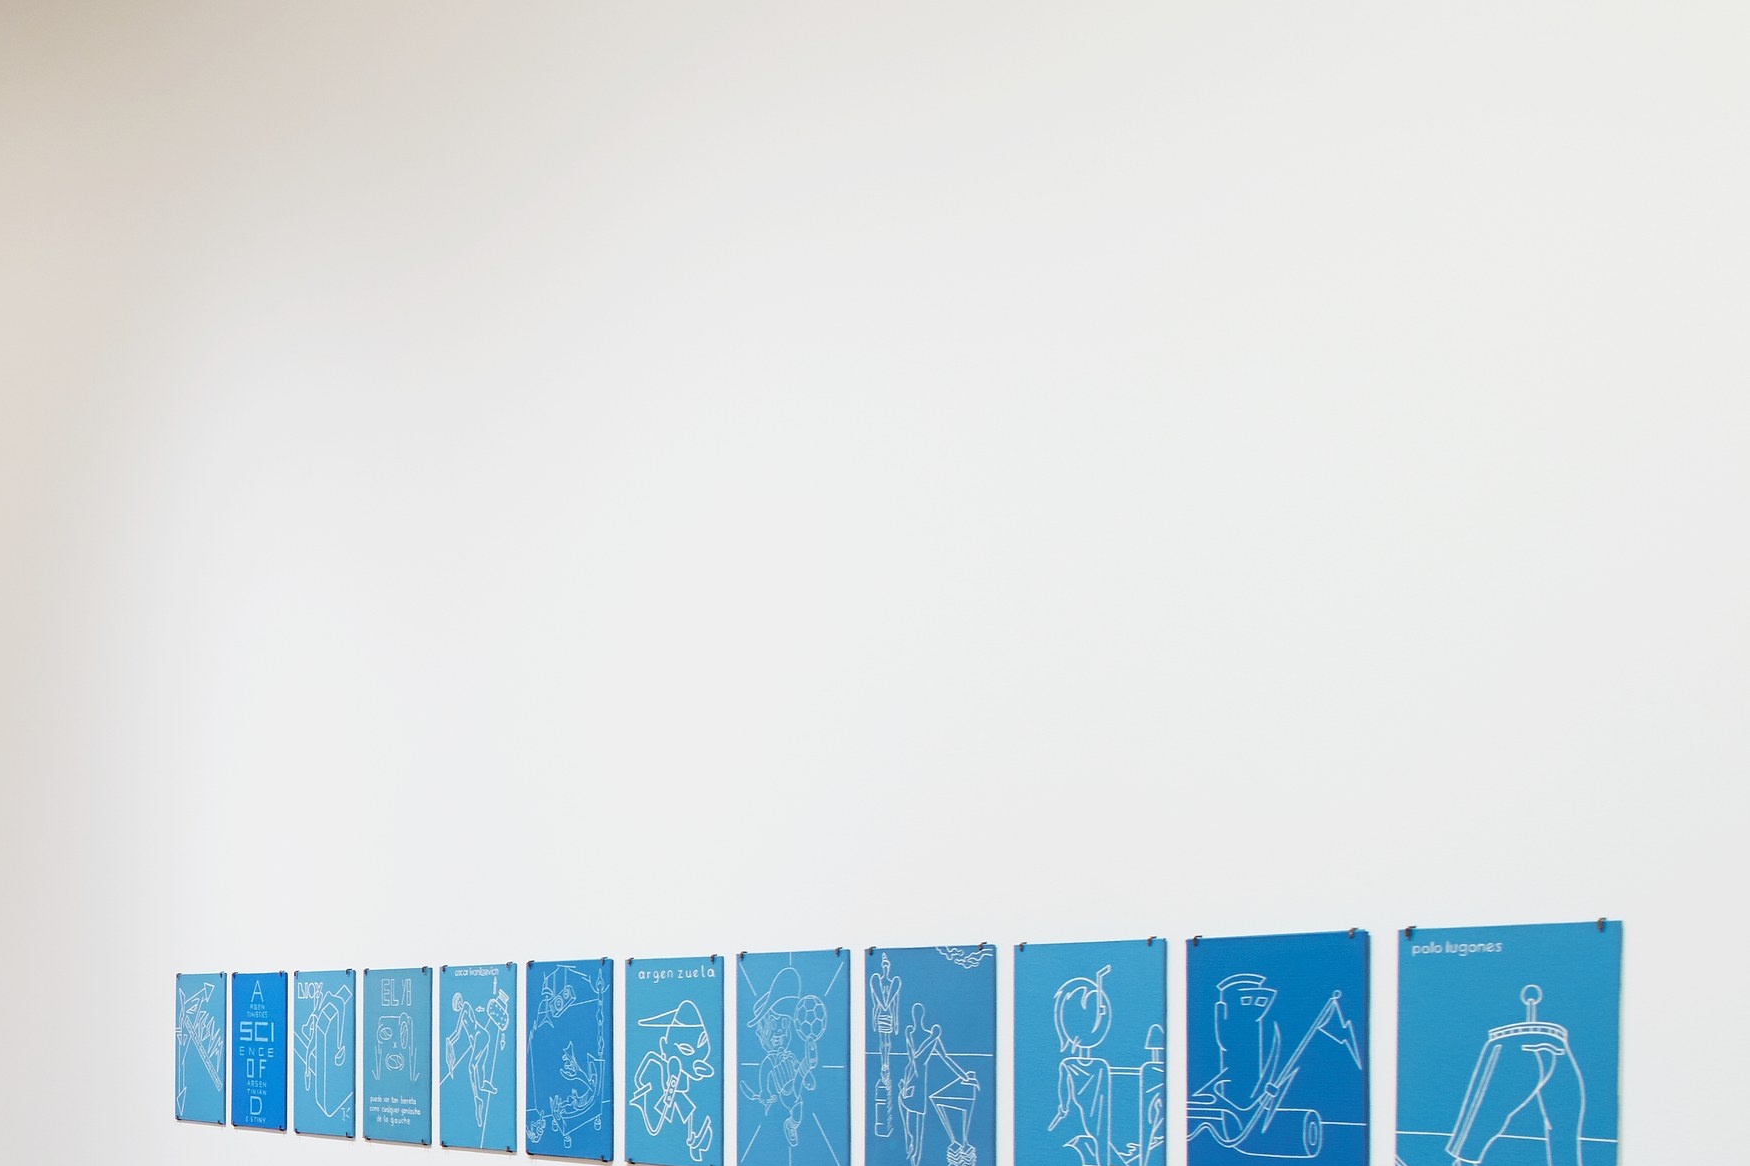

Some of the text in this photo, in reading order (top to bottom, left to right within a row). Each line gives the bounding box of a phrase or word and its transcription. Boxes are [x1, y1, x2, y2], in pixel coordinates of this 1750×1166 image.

[1412, 941, 1503, 957] polo lugones
[250, 980, 265, 1003] A
[239, 1021, 275, 1043] SCI
[239, 1046, 274, 1058] ENCE
[246, 1058, 267, 1079] OF
[247, 1080, 267, 1088] ARGEN
[250, 1095, 263, 1116] D
